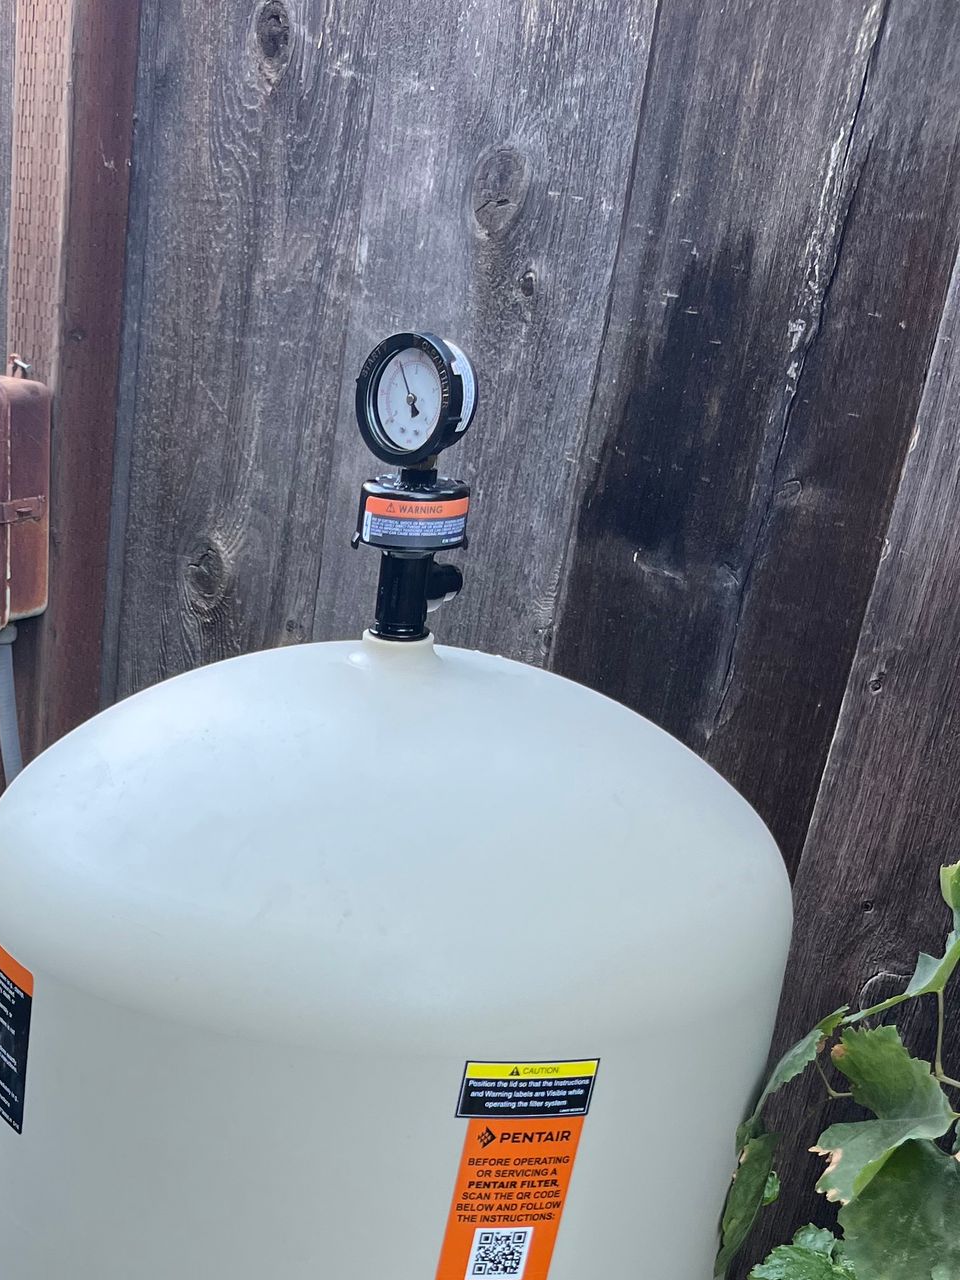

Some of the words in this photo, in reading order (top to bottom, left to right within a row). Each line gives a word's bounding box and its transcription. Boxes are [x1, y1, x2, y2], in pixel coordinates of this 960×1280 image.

[361, 347, 384, 378] START
[399, 505, 443, 514] WARNING
[522, 1066, 559, 1075] CAUTION
[468, 1080, 495, 1088] Position
[528, 1079, 541, 1087] that
[542, 1079, 552, 1087] the
[485, 1089, 512, 1099] Warning
[514, 1089, 533, 1097] labels
[546, 1089, 566, 1097] Visible
[485, 1100, 516, 1109] operating
[529, 1099, 543, 1107] filter
[544, 1100, 567, 1108] system
[499, 1130, 571, 1143] PENTAIR
[468, 1157, 511, 1166] BEFORE
[513, 1155, 570, 1166] OPERATING
[476, 1169, 492, 1178] OR
[494, 1168, 548, 1177] SERVICING
[550, 1168, 557, 1176] A
[467, 1180, 517, 1188] PENTAIR
[462, 1192, 490, 1200] SCAN
[494, 1192, 513, 1200] THE
[516, 1191, 531, 1200] QR
[533, 1190, 561, 1199] CODE
[456, 1203, 494, 1211] BELOW
[496, 1203, 518, 1211] AND
[520, 1201, 561, 1210] FOLLOW
[480, 1212, 555, 1222] INSTRUCTIONS:
